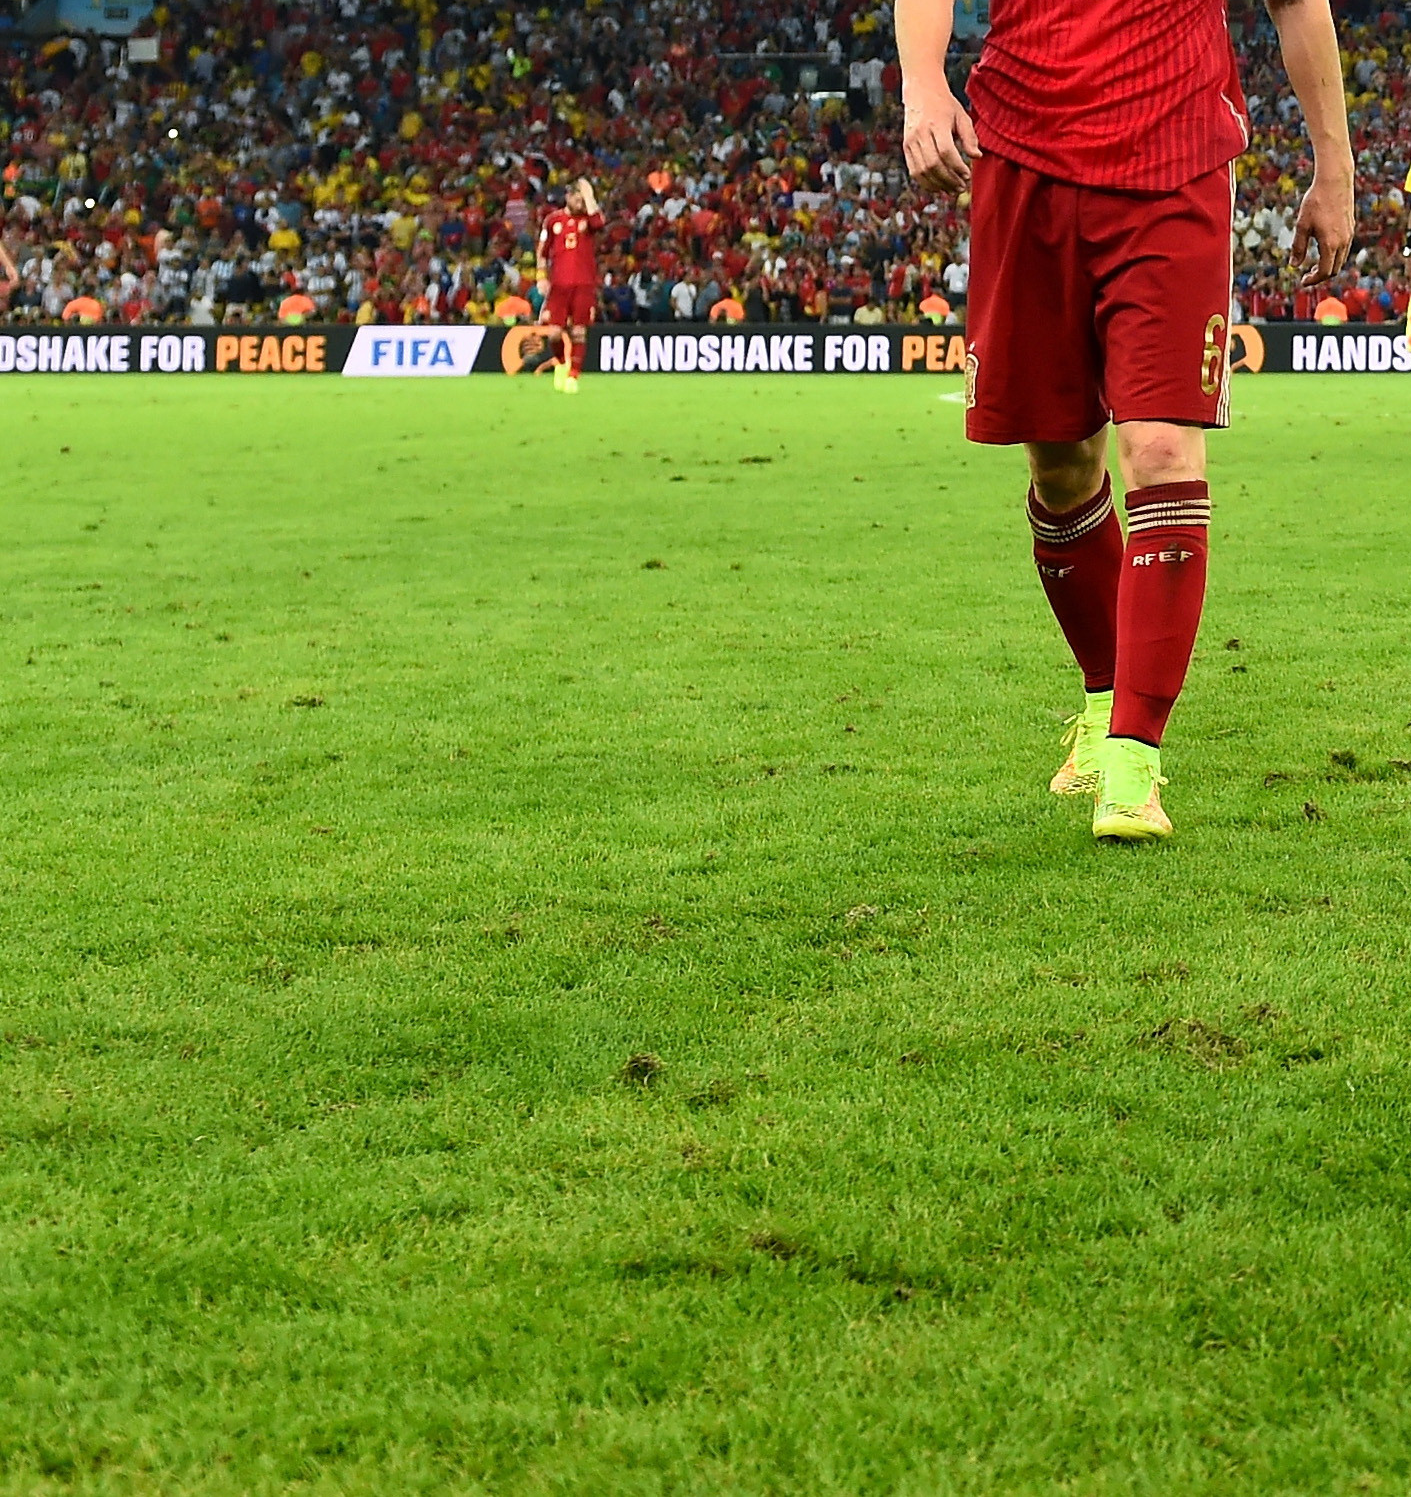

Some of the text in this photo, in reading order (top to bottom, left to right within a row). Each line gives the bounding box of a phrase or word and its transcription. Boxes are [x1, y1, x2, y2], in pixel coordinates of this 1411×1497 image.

[140, 334, 204, 374] FOR
[215, 334, 327, 373] PEACE
[370, 339, 457, 369] FIFA
[600, 335, 818, 372] HANDSHAKE
[824, 335, 891, 372] FOR
[1199, 313, 1225, 396] 6
[1132, 550, 1195, 567] RFEF
